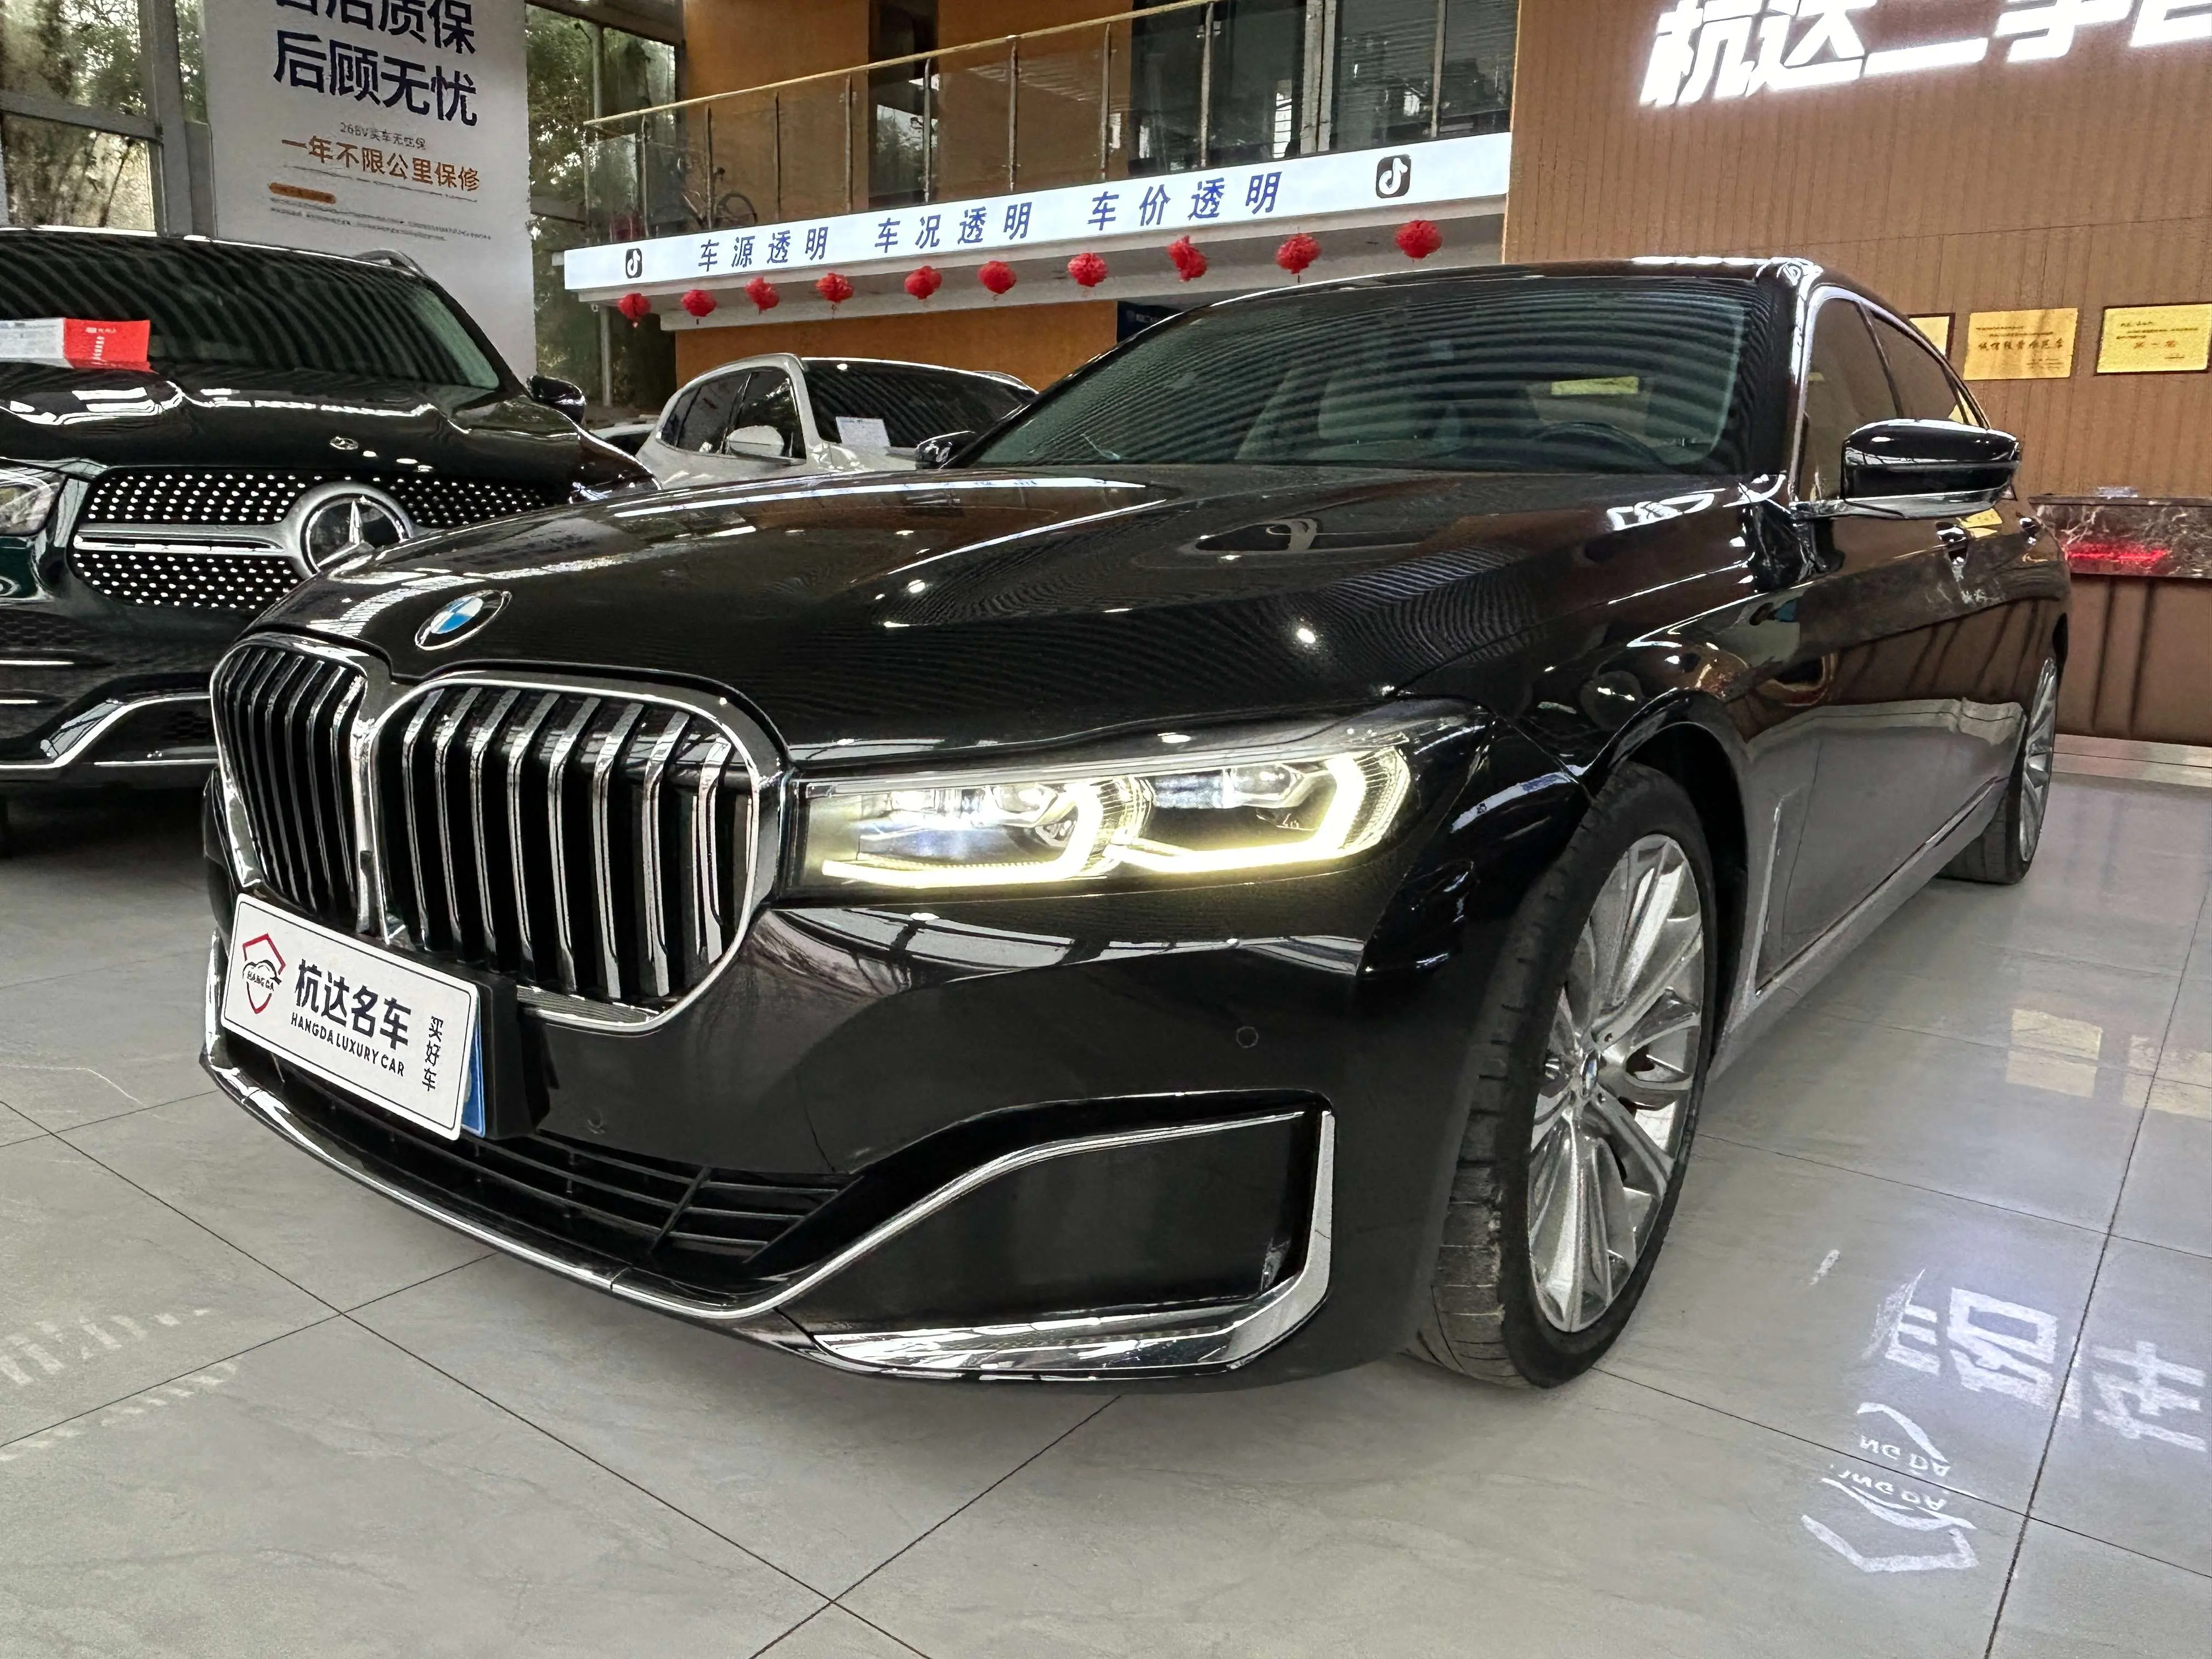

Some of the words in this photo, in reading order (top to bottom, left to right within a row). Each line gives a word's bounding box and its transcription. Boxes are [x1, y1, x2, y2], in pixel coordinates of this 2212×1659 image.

[276, 0, 476, 54] 质保
[273, 30, 477, 126] 后顾无忧
[281, 135, 480, 192] 一年不限公里保修
[697, 225, 829, 272] 车源透明
[874, 201, 1032, 253] 车况透明
[1087, 171, 1283, 230] 车价透明
[294, 958, 411, 1050] 杭达名车
[290, 1012, 334, 1044] HANGDA
[335, 1035, 380, 1065] LUXURY
[380, 1054, 404, 1077] CAR
[422, 1015, 444, 1092] 买好车
